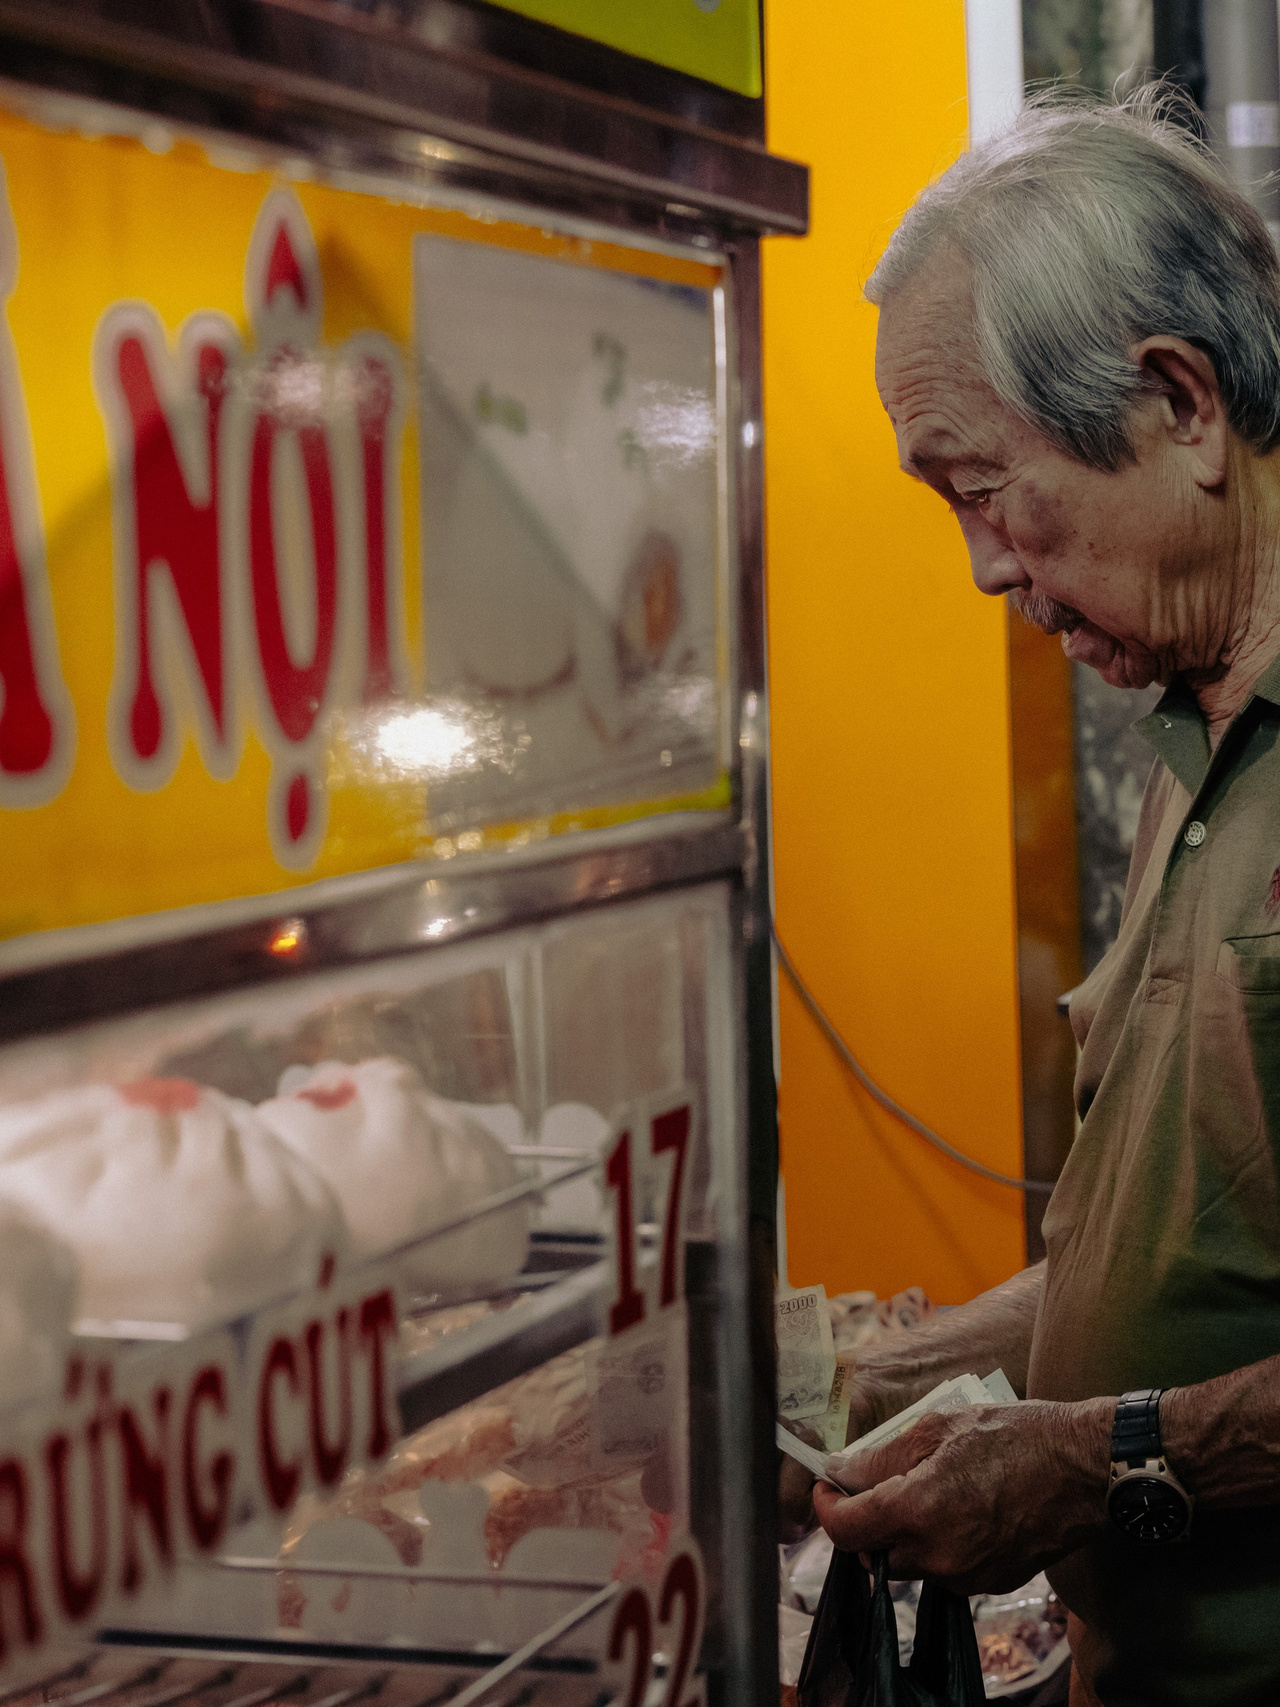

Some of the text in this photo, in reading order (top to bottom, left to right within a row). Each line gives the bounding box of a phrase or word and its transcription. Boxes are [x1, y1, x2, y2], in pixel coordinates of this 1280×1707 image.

[106, 205, 398, 858] NỘI
[605, 1103, 690, 1338] 17
[779, 1294, 818, 1315] 2000
[257, 1250, 398, 1511] CÚT
